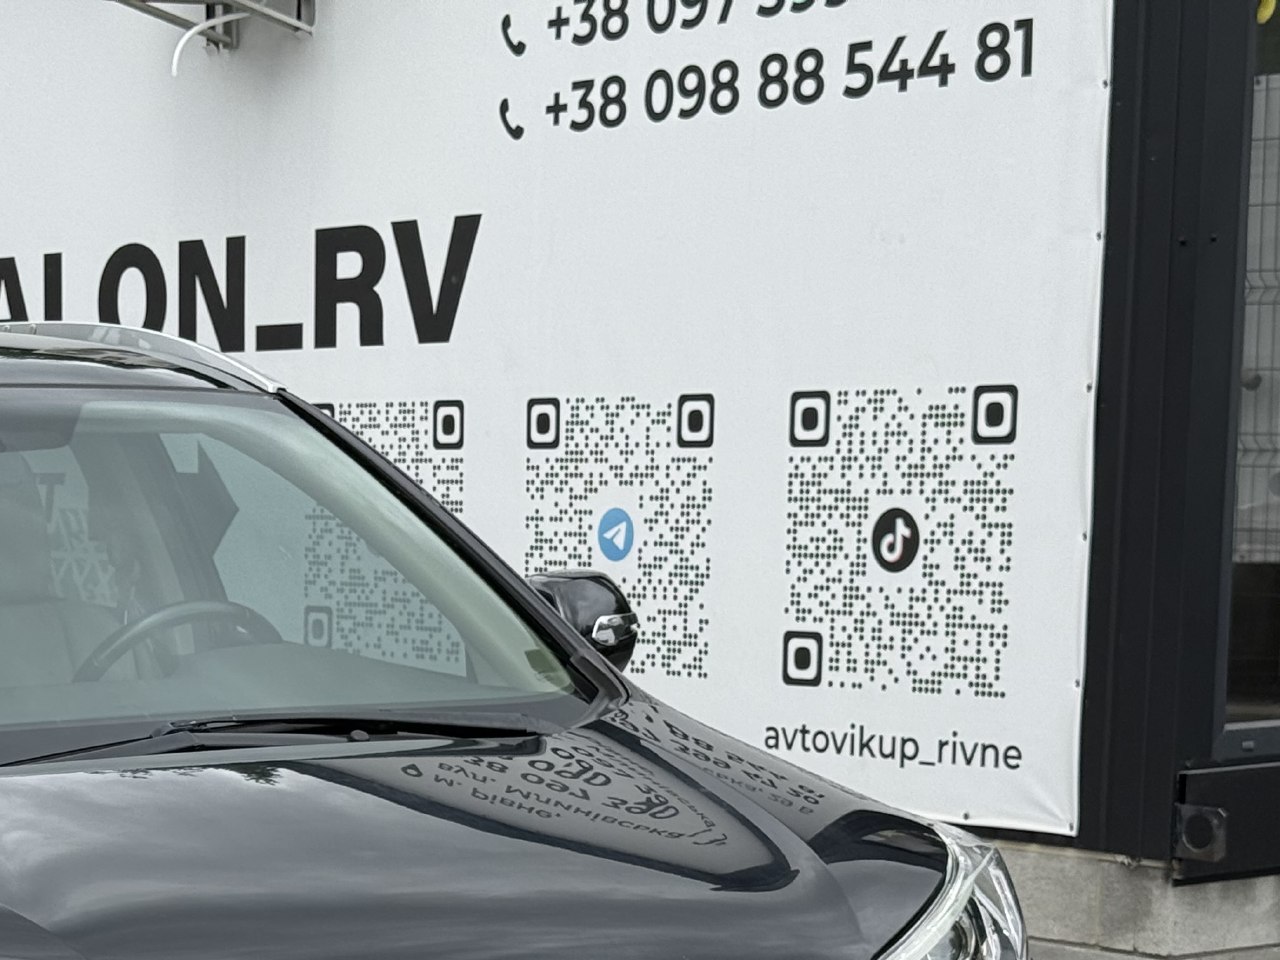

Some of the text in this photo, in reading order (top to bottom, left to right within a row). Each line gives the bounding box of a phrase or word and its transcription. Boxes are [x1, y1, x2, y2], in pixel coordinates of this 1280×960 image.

[547, 0, 629, 46] +38
[545, 18, 1035, 132] +38 098 88 544 81
[764, 723, 1023, 770] avtovikup_rivne
